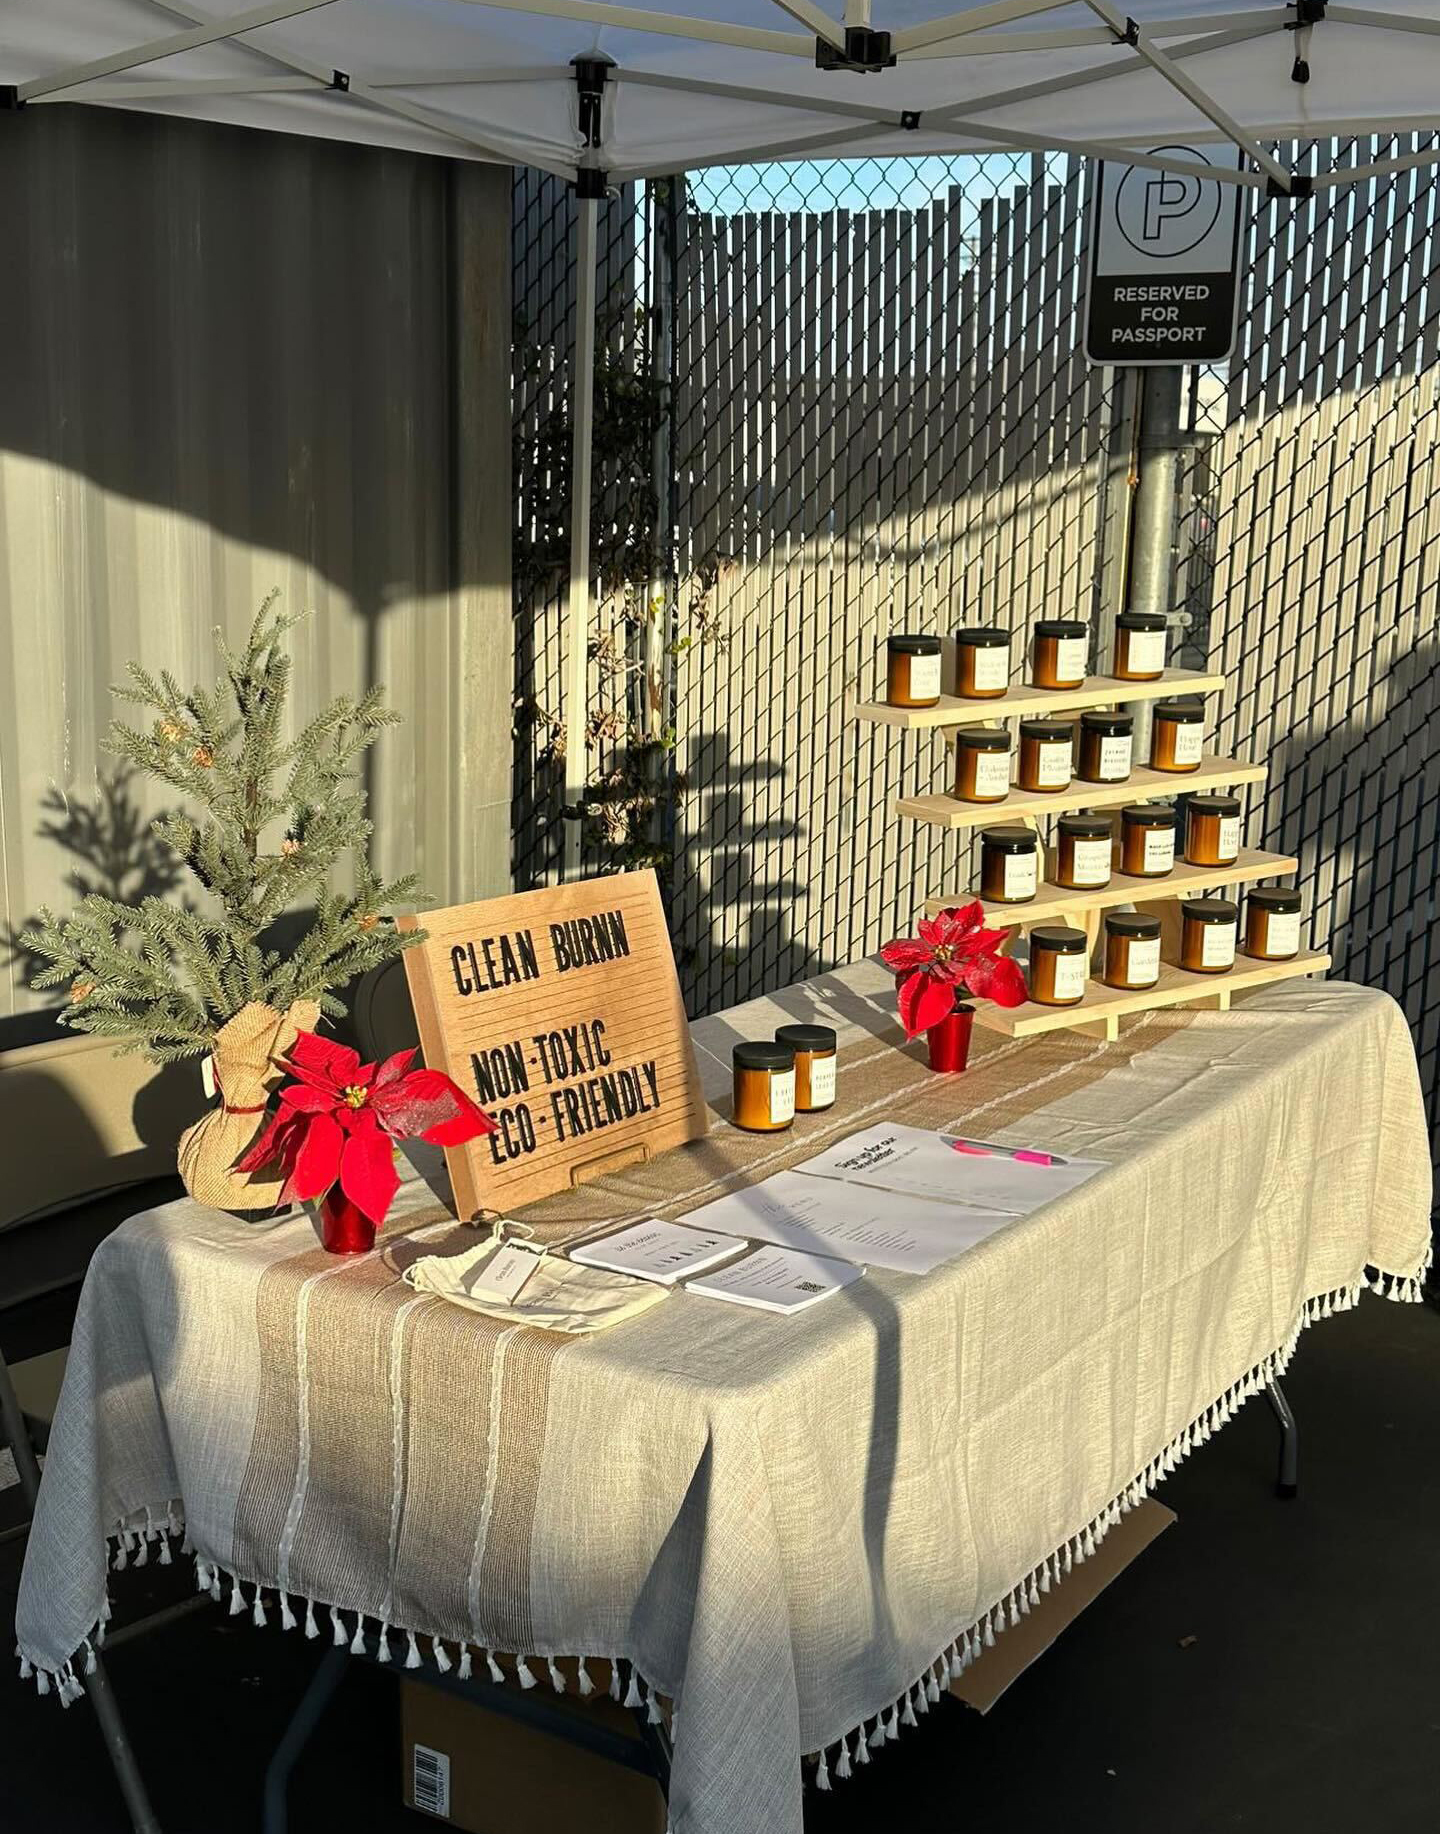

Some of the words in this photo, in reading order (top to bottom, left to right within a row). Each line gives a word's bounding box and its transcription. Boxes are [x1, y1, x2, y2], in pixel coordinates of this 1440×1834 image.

[1113, 285, 1210, 302] RESERVED
[1140, 307, 1179, 322] FOR
[1111, 326, 1207, 343] PASSPORT
[450, 929, 540, 996] CLEAN
[550, 910, 631, 974] BURNN
